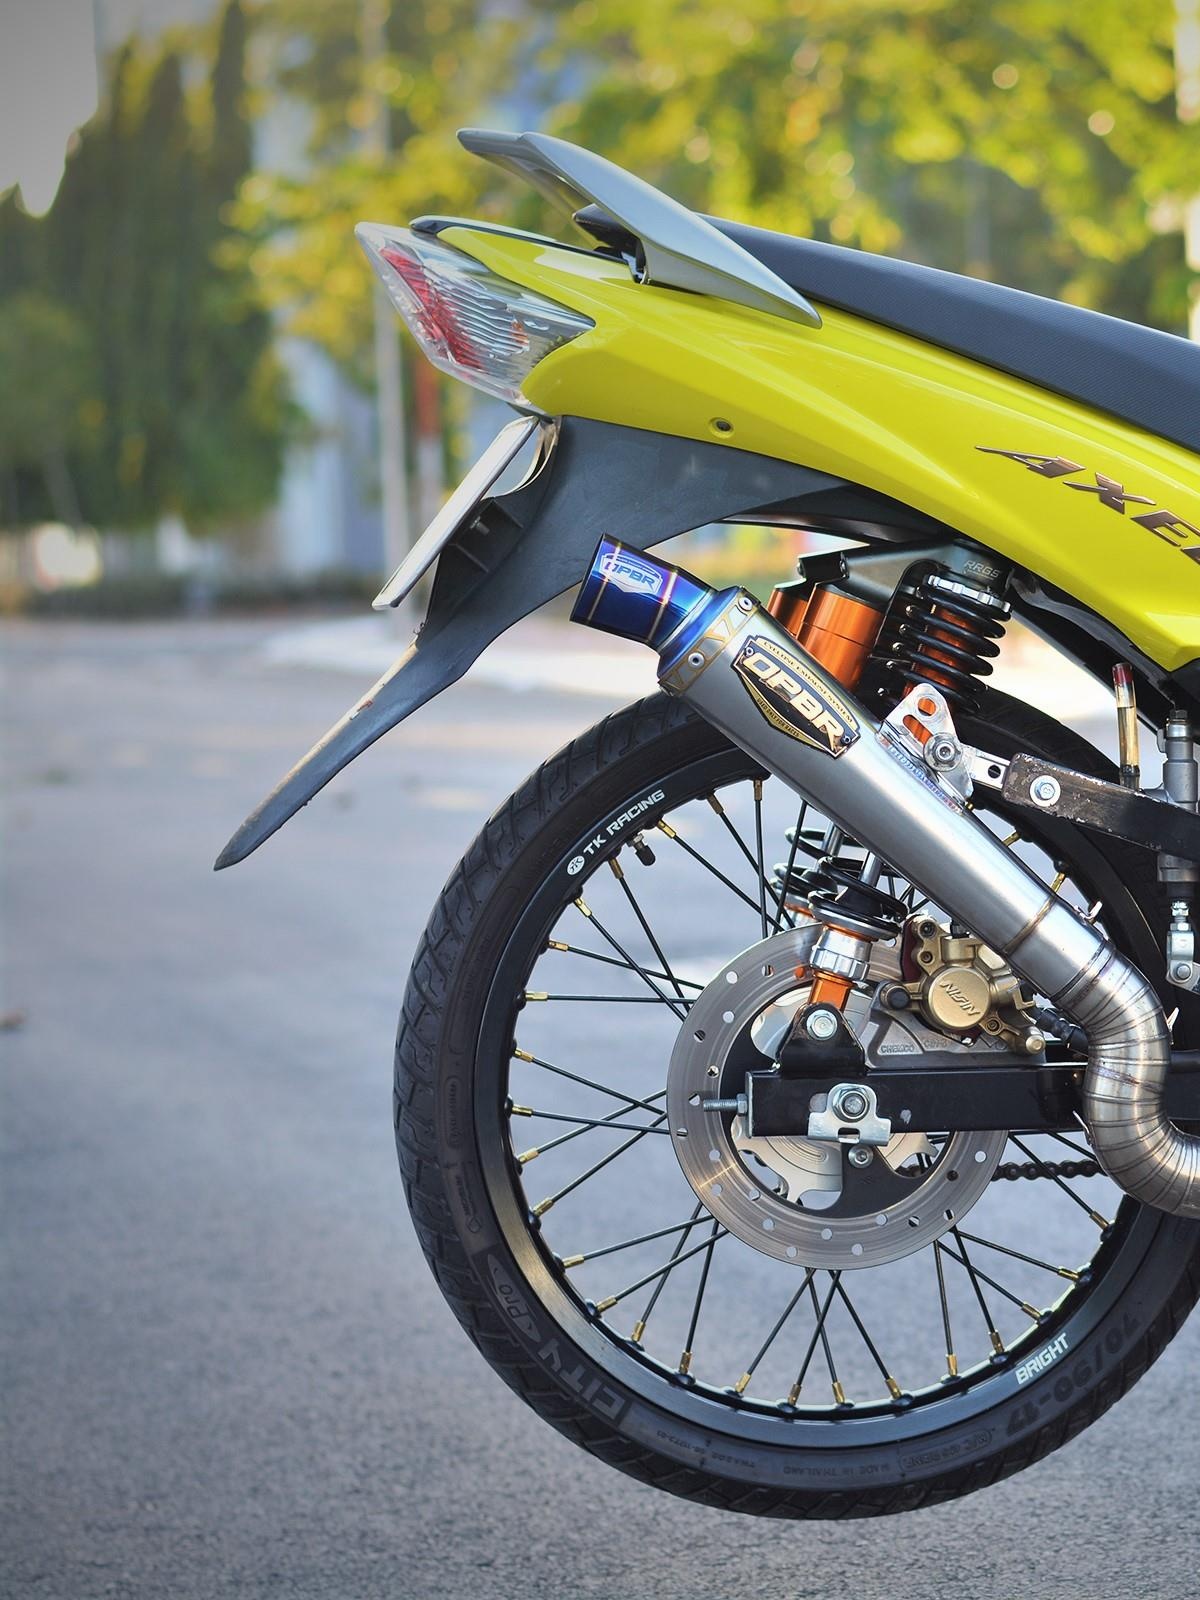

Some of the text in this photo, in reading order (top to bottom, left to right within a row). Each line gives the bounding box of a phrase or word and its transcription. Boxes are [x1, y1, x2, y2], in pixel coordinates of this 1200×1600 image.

[963, 560, 1001, 578] RRGS
[742, 652, 845, 752] OPBR
[828, 693, 854, 724] SYSTEM
[583, 834, 607, 855] TK
[606, 789, 666, 836] RACING
[537, 1338, 626, 1421] CITY
[1014, 1333, 1070, 1385] BRIGHT
